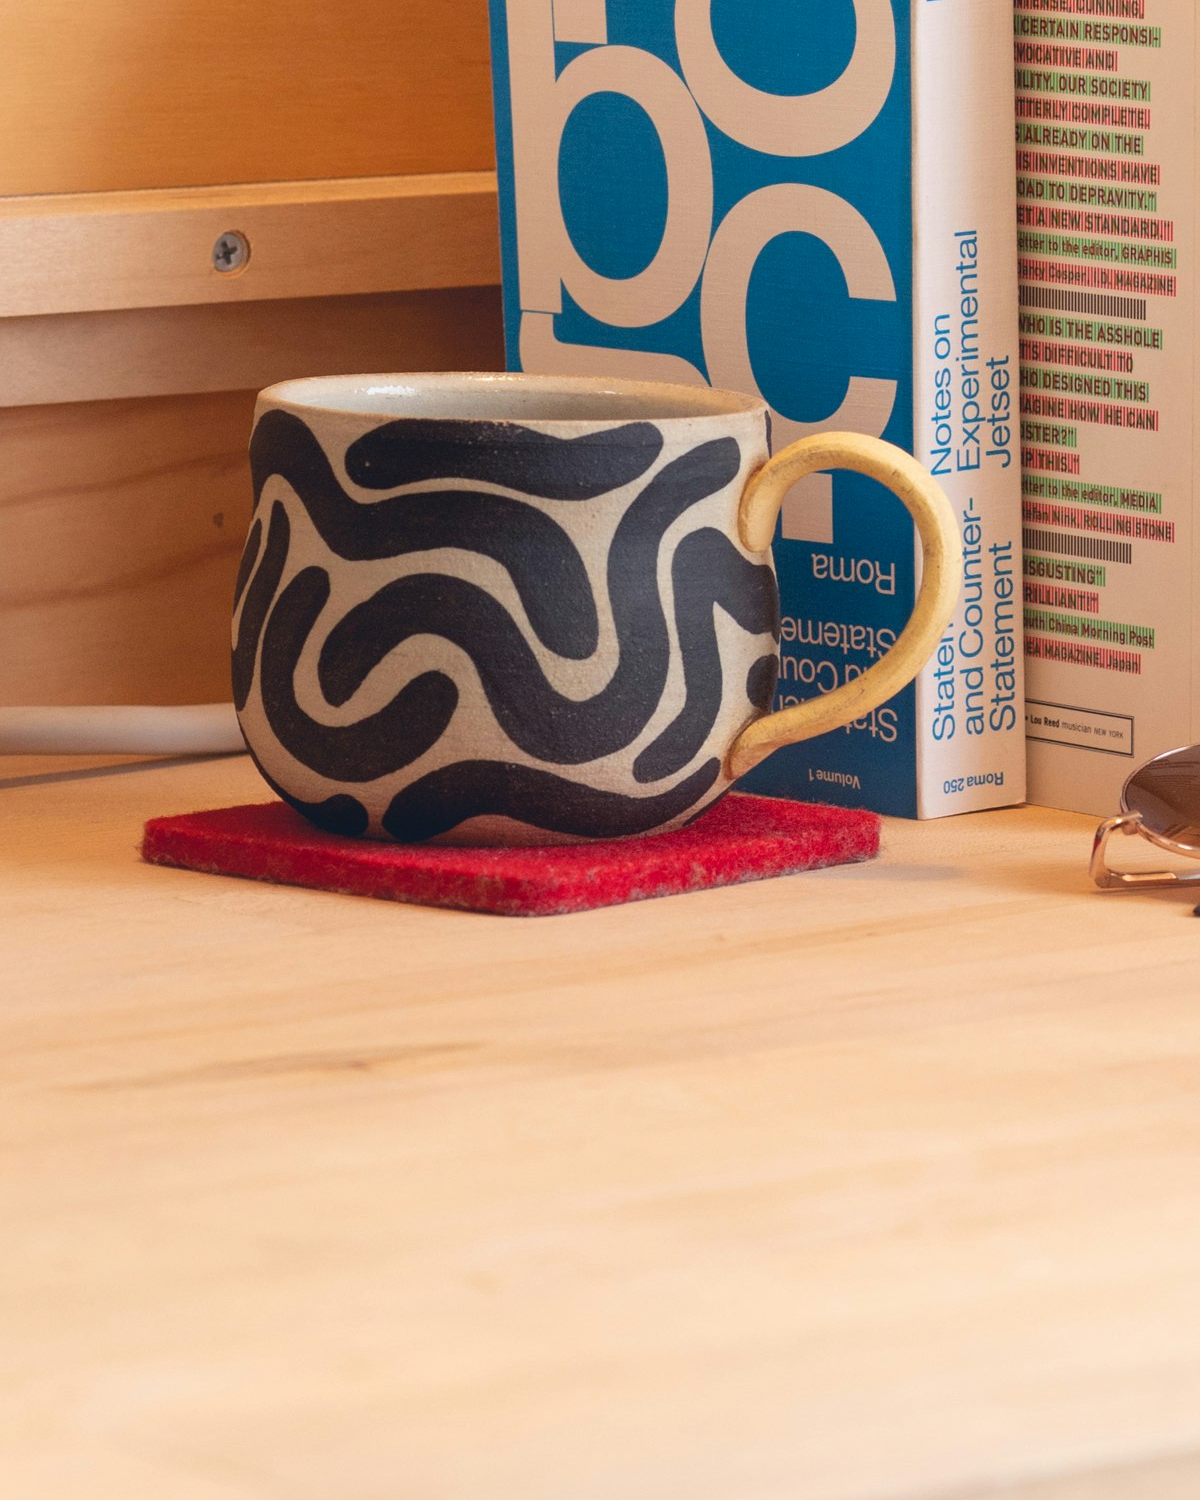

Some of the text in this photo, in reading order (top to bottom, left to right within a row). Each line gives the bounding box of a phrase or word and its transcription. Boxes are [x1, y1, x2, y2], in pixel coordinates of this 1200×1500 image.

[1022, 18, 1079, 38] CERTAIN
[1084, 23, 1160, 46] RESPONSI-
[1085, 51, 1115, 70] AND
[1059, 75, 1148, 100] OUR SOCIETY
[1024, 129, 1087, 147] ALREADY
[1091, 133, 1110, 151] ON
[1115, 135, 1141, 154] THE
[1035, 153, 1117, 178] INVENTIONS
[1122, 164, 1157, 184] HAVE
[1049, 183, 1065, 200] TO
[1051, 211, 1081, 229] NEW
[1048, 239, 1058, 251] to
[1061, 239, 1079, 254] the
[1122, 247, 1172, 266] GRAPHIS
[1115, 274, 1174, 293] MAGAZINE
[1067, 321, 1160, 349] THE ASSHOLE
[954, 230, 986, 472] Experimental
[1044, 346, 1134, 373] DIFFICULT TO
[930, 314, 951, 476] Notes on
[1043, 373, 1146, 401] DESIGNED THIS
[985, 355, 1011, 468] Jetset
[1070, 401, 1156, 431] HOW HE CAN
[1048, 483, 1157, 510] to the MEDIA
[1084, 514, 1172, 540] ROLLING STONE
[811, 553, 896, 596] Roma
[959, 497, 985, 735] and Counter-
[988, 541, 1016, 731] Statement
[1048, 618, 1154, 646] China Morning Post
[1107, 656, 1138, 673] Japan
[1030, 714, 1125, 740] Lou Reed musician NEW YORK
[808, 767, 861, 790] Volume 1
[943, 771, 1004, 794] Roma 250
